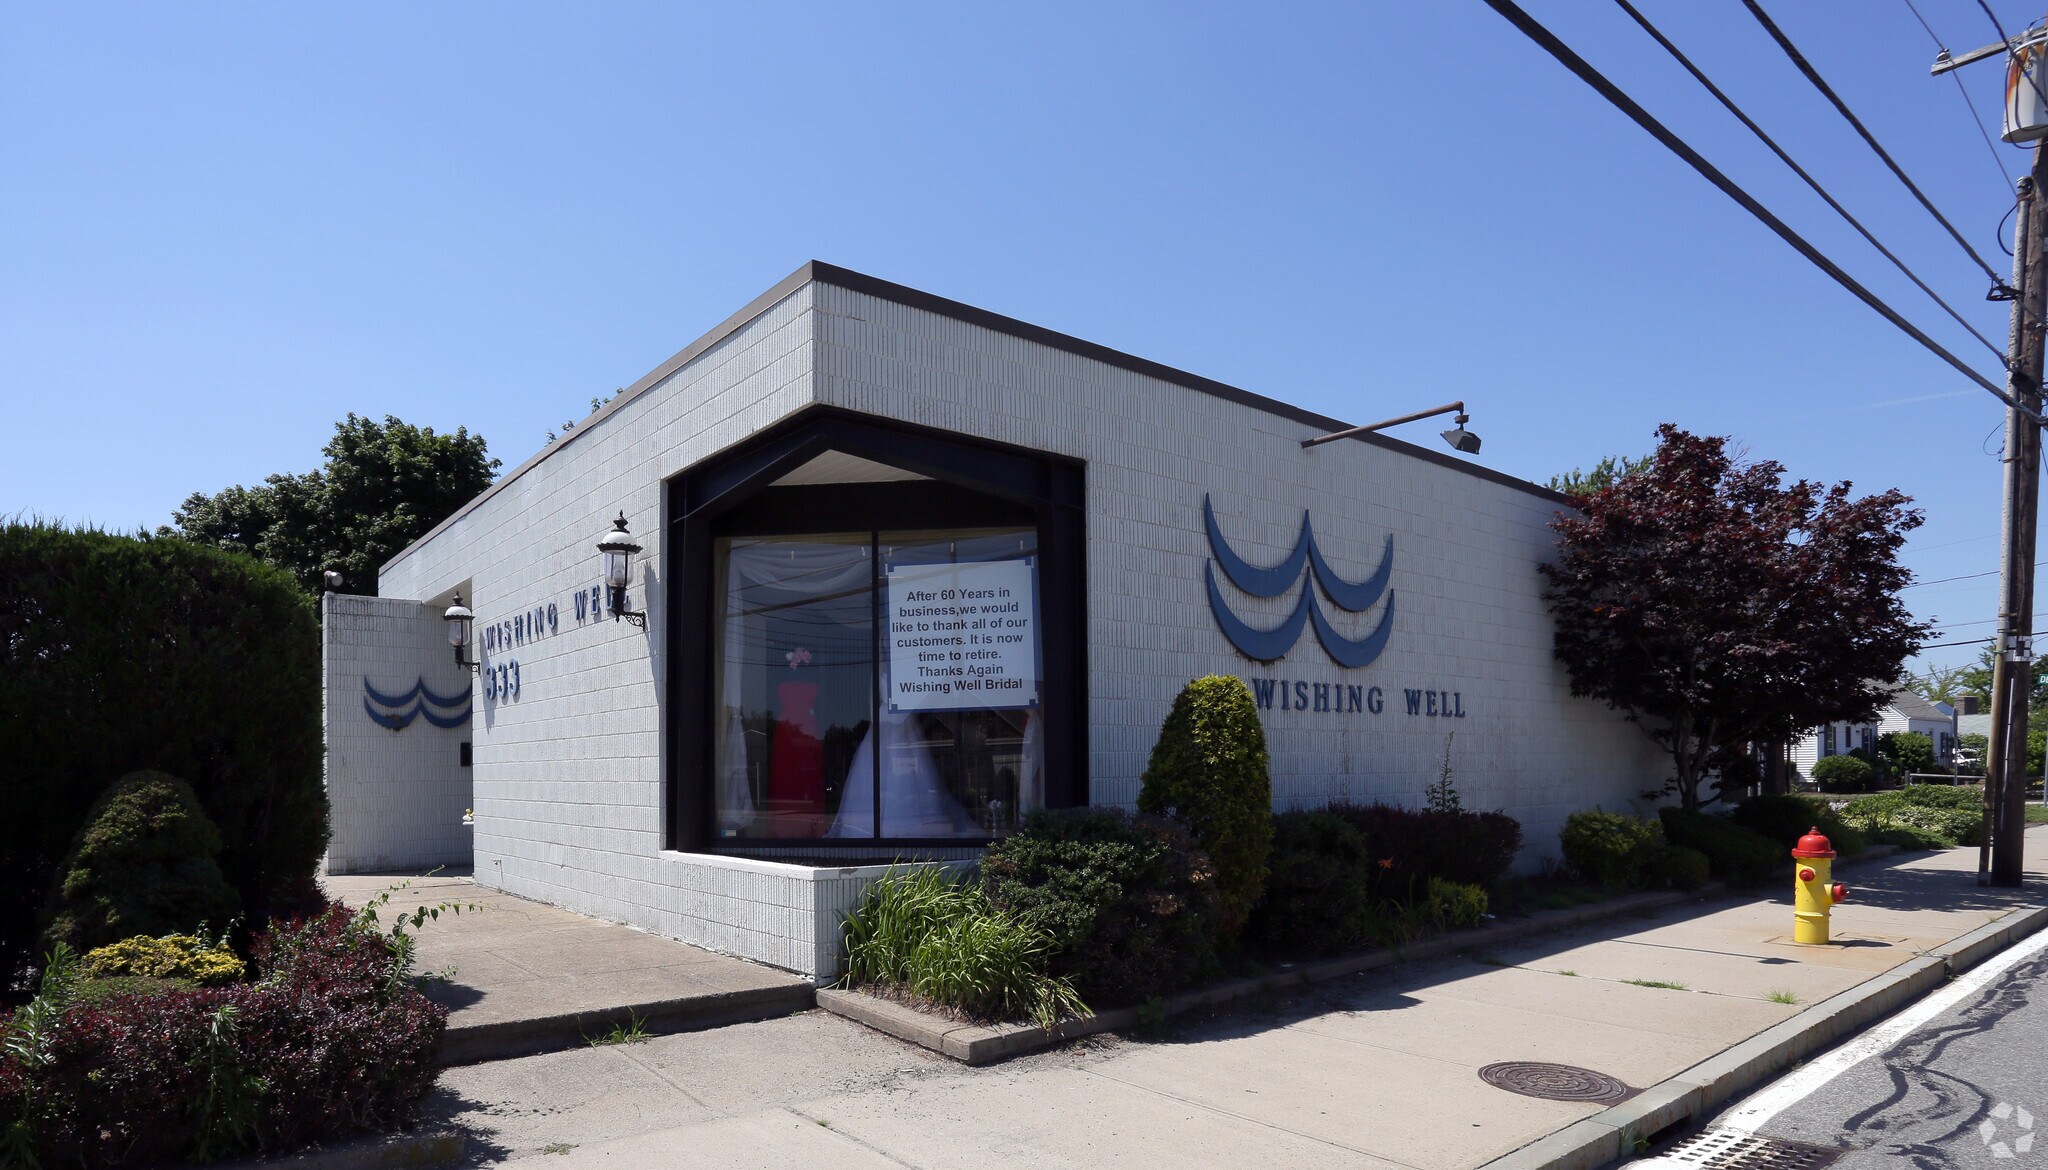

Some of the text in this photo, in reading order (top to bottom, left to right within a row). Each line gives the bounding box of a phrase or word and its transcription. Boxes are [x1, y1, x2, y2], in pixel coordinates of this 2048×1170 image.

[907, 587, 1010, 602] After 60 Years in
[981, 602, 1019, 614] would
[486, 582, 629, 650] WISHING WEL
[892, 618, 1028, 633] like to thank all of our
[897, 633, 1024, 648] customers. It is now
[918, 649, 1002, 662] time to retire.
[917, 664, 1004, 678] Thanks Again
[486, 658, 520, 701] 333
[899, 678, 1023, 694] Wishing Well Bridal
[1252, 678, 1466, 719] WISHING WELL
